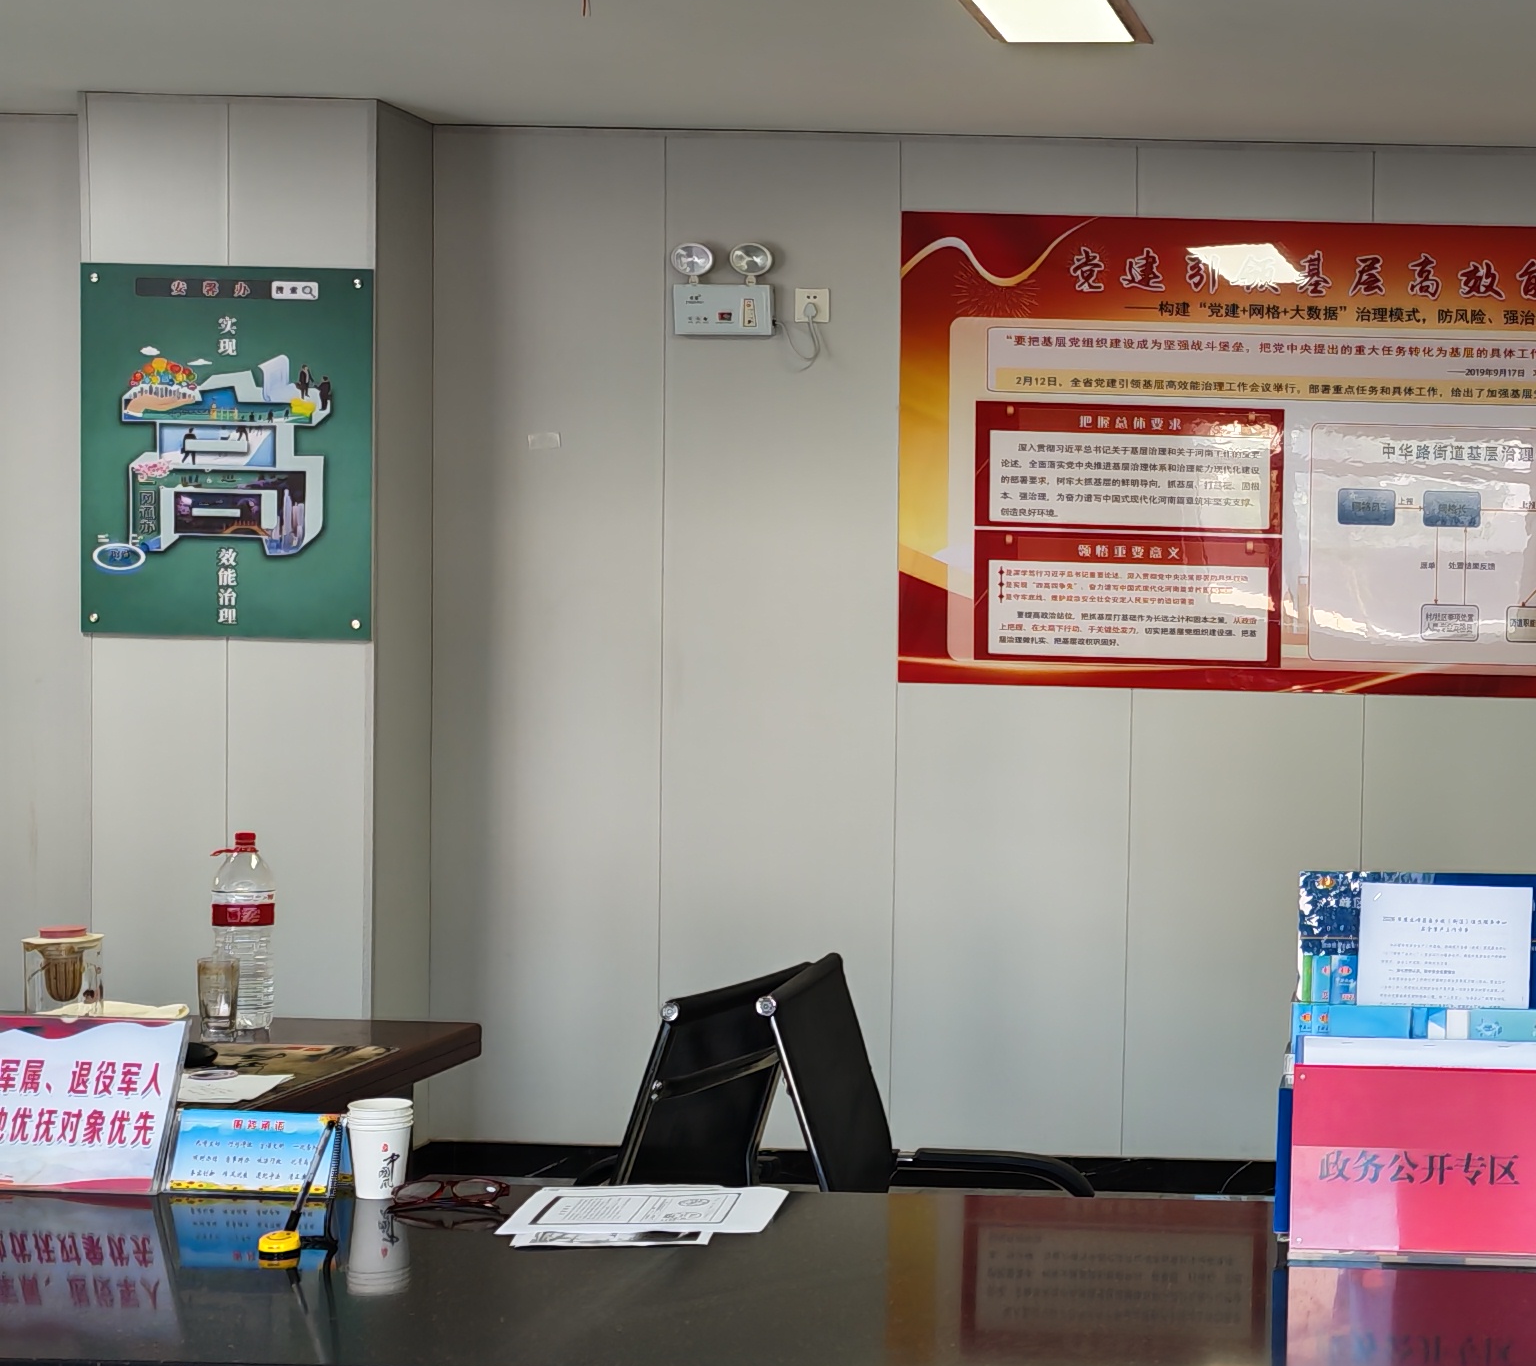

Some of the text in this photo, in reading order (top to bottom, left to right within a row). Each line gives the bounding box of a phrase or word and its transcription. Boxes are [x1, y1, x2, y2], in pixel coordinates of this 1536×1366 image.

[217, 315, 238, 356] 实现
[1079, 415, 1182, 430] 把握总体要求
[217, 547, 238, 624] 效能治理
[1319, 1149, 1520, 1186] 政务公开专区
